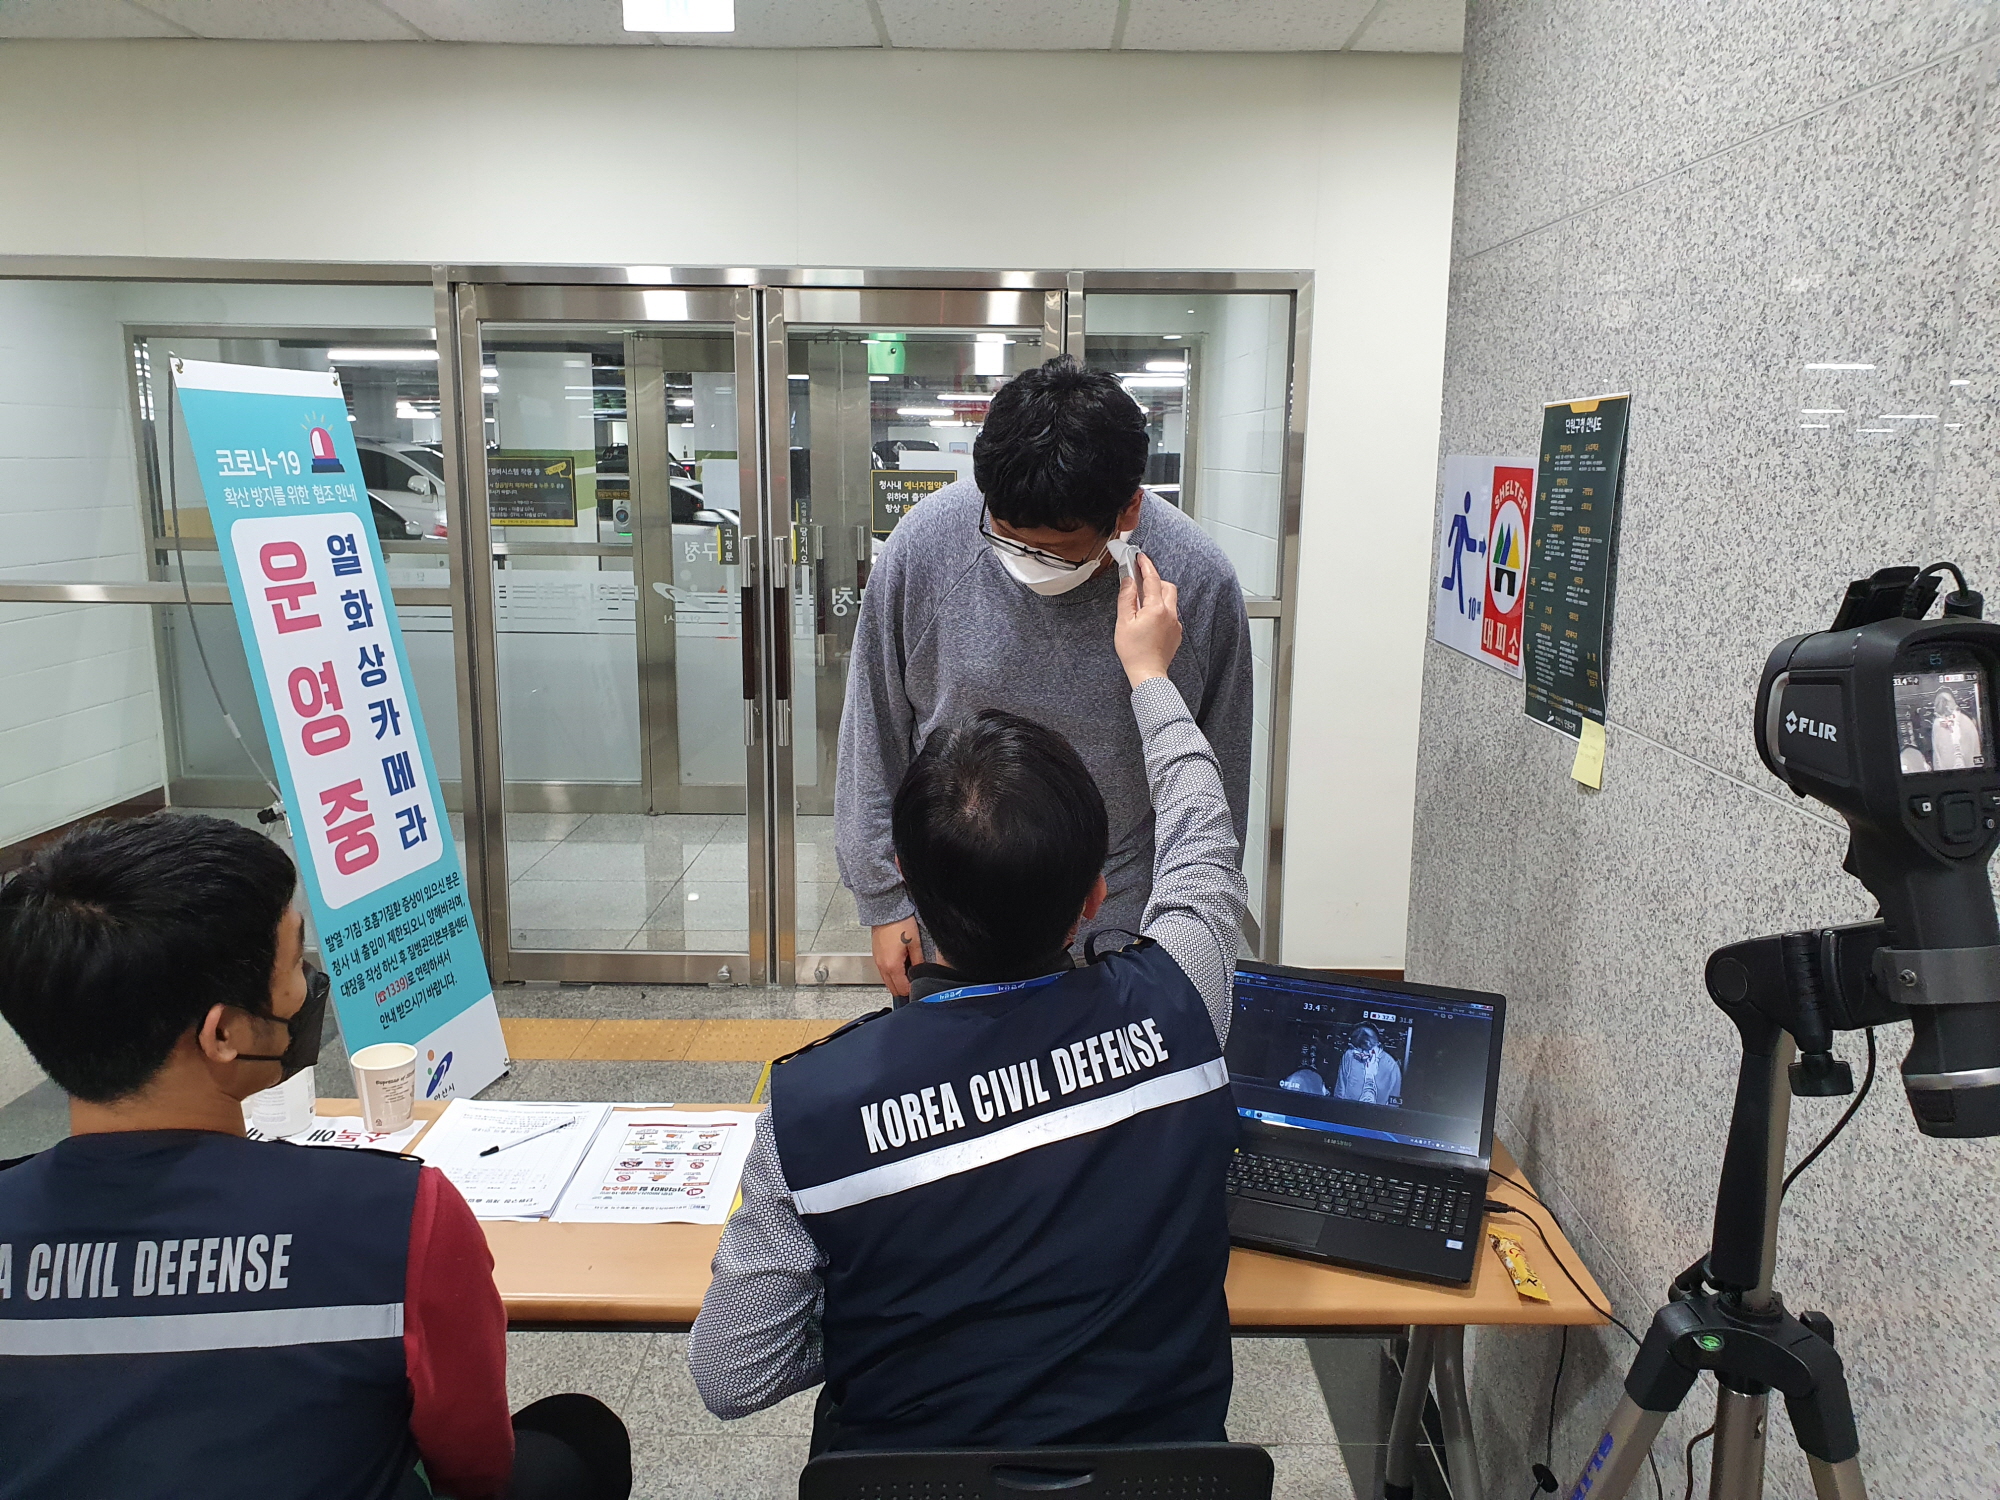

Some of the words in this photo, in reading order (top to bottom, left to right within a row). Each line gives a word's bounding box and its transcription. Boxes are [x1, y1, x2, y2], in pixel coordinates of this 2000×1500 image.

[216, 448, 301, 479] 코로나-19
[223, 487, 251, 508] 확산
[250, 486, 287, 508] 방지를
[286, 485, 310, 505] 위한
[312, 484, 336, 504] 협조
[335, 483, 358, 503] 안내
[879, 480, 901, 490] 청사내
[886, 492, 909, 502] 위하여
[1494, 480, 1528, 515] SHELTER
[885, 504, 901, 514] 항상
[724, 528, 735, 562] 고정문
[800, 527, 809, 564] 당기시오
[1483, 617, 1519, 662] 대피소
[259, 540, 381, 876] 운영중
[327, 533, 428, 851] 열화상카메라
[1798, 716, 1837, 742] FLIR
[401, 888, 425, 913] 증상이
[424, 879, 446, 901] 있으신
[446, 871, 461, 890] 분은
[332, 951, 350, 977] 청사
[351, 949, 361, 965] 내
[361, 934, 387, 961] 출입이
[387, 913, 427, 945] 제한되오니
[340, 973, 366, 998] 대장을
[365, 964, 383, 983] 작성
[382, 953, 400, 973] 하신
[398, 950, 408, 965] 후
[407, 915, 469, 961] 질병관리본부콜센터
[415, 949, 452, 980] 연락하셔서
[379, 1011, 397, 1030] 안내
[396, 989, 428, 1020] 받으시기
[427, 972, 458, 999] 바랍니다.
[1303, 1003, 1321, 1012] 33.4
[860, 1082, 966, 1154] KOREA
[969, 1058, 1050, 1123] CIVIL
[1050, 1017, 1169, 1096] DEFENSE
[26, 1242, 119, 1301] CIVIL
[133, 1233, 293, 1297] DEFENSE
